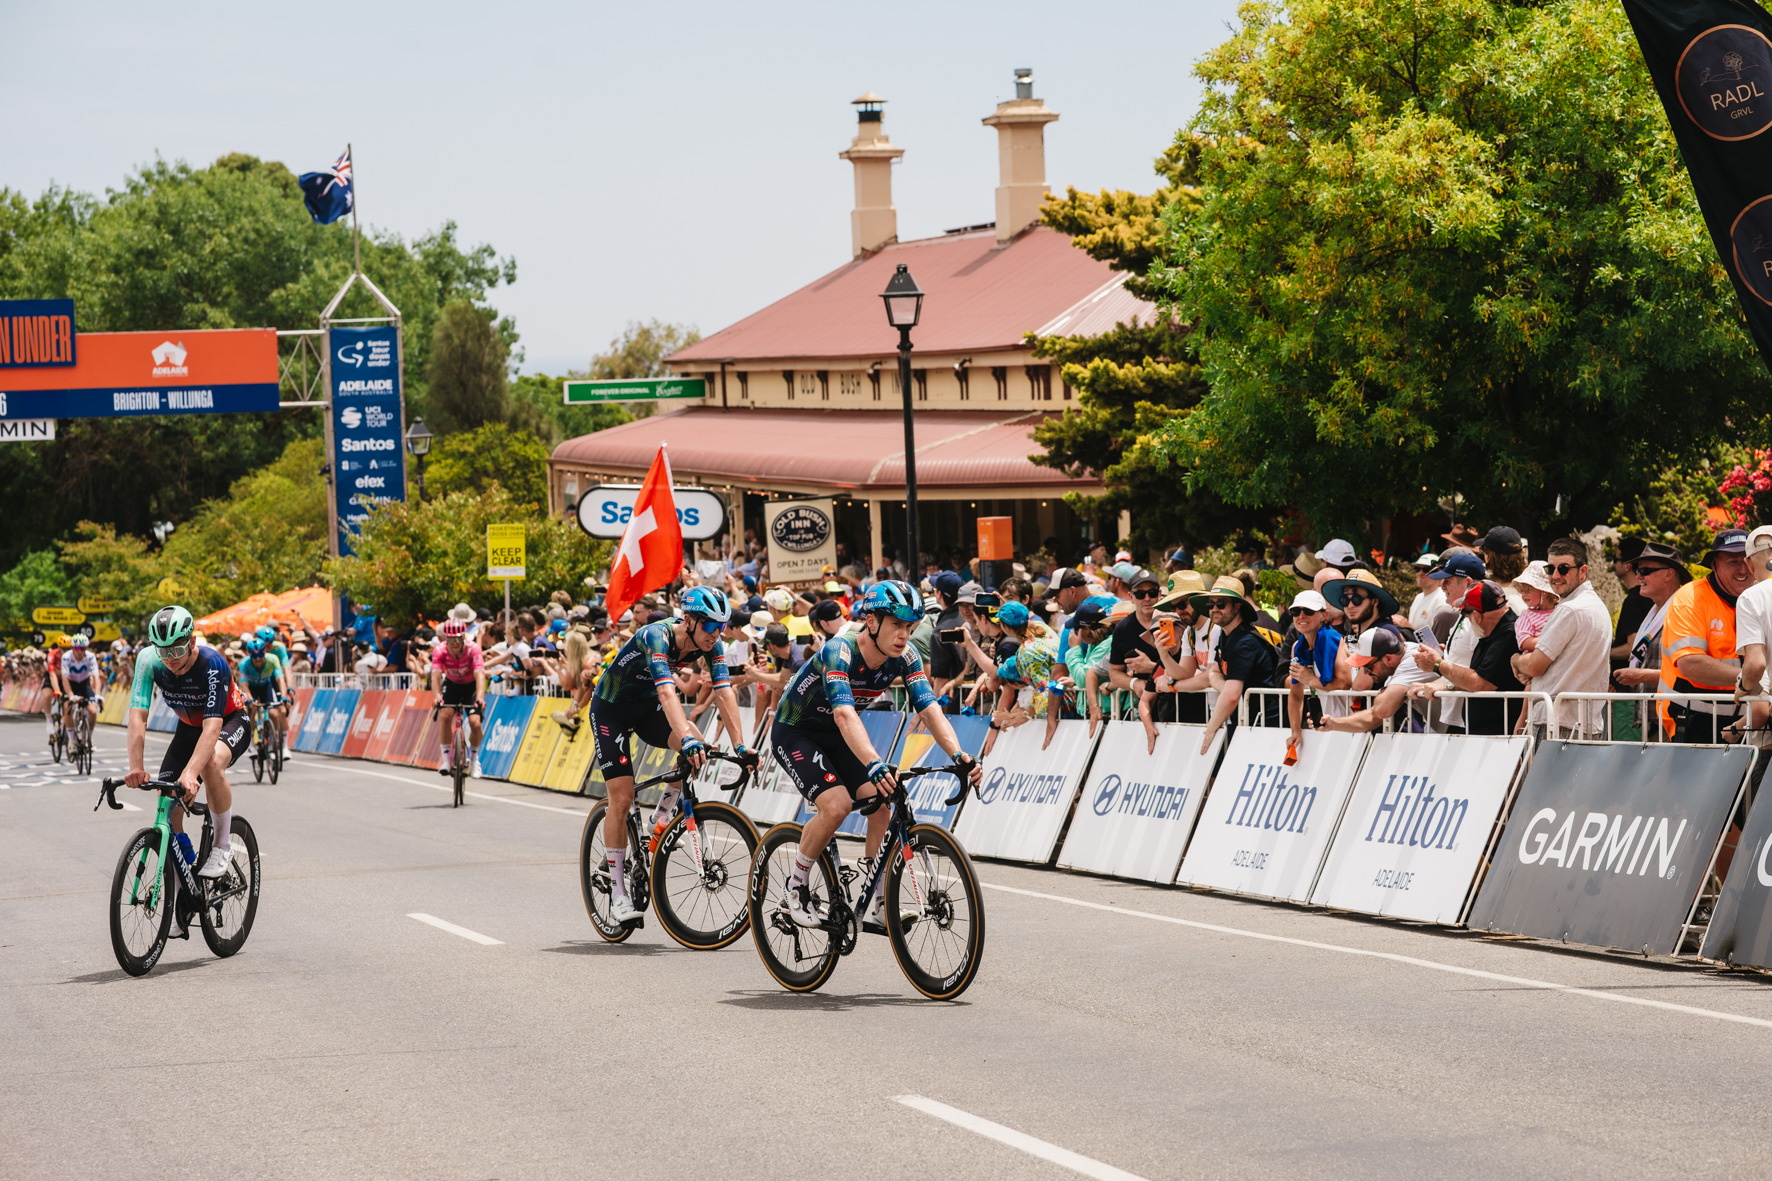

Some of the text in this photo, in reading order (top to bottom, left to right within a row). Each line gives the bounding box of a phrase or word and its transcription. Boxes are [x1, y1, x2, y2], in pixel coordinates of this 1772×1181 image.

[1710, 81, 1764, 111] RADL
[1730, 106, 1754, 120] GRVL
[12, 315, 72, 364] UNDER
[152, 366, 189, 374] ADELAIDE
[339, 379, 393, 391] ADELAIDE
[800, 373, 815, 394] OLD
[840, 373, 861, 394] BUSH
[113, 392, 160, 411] BRIGHTON
[167, 390, 214, 410] WILLUNGA
[366, 413, 394, 421] WORLD
[367, 419, 387, 427] TOUR
[341, 438, 395, 452] Santos
[355, 475, 385, 489] efex
[776, 509, 826, 530] OLD BUSH
[790, 519, 811, 529] INN
[492, 548, 522, 556] KEEP
[492, 557, 522, 566] CLEAR
[777, 561, 798, 569] OPEN
[808, 558, 829, 567] DAYS
[618, 650, 642, 668] SOUDAL
[207, 669, 220, 708] Adecco
[797, 672, 821, 695] SOUDAL
[1001, 772, 1068, 805] HYUNDAI
[1225, 763, 1317, 833] Hilton
[1118, 781, 1190, 821] HYUNDAI
[1364, 774, 1469, 850] Hilton
[1518, 807, 1688, 882] GARMIN
[171, 836, 198, 896] VAN RYSEL
[860, 829, 892, 904] S-WORKS
[1231, 849, 1269, 870] ADELAIDE
[752, 844, 769, 902] roval
[1372, 868, 1415, 891] ADELAIDE
[943, 949, 970, 991] roval
